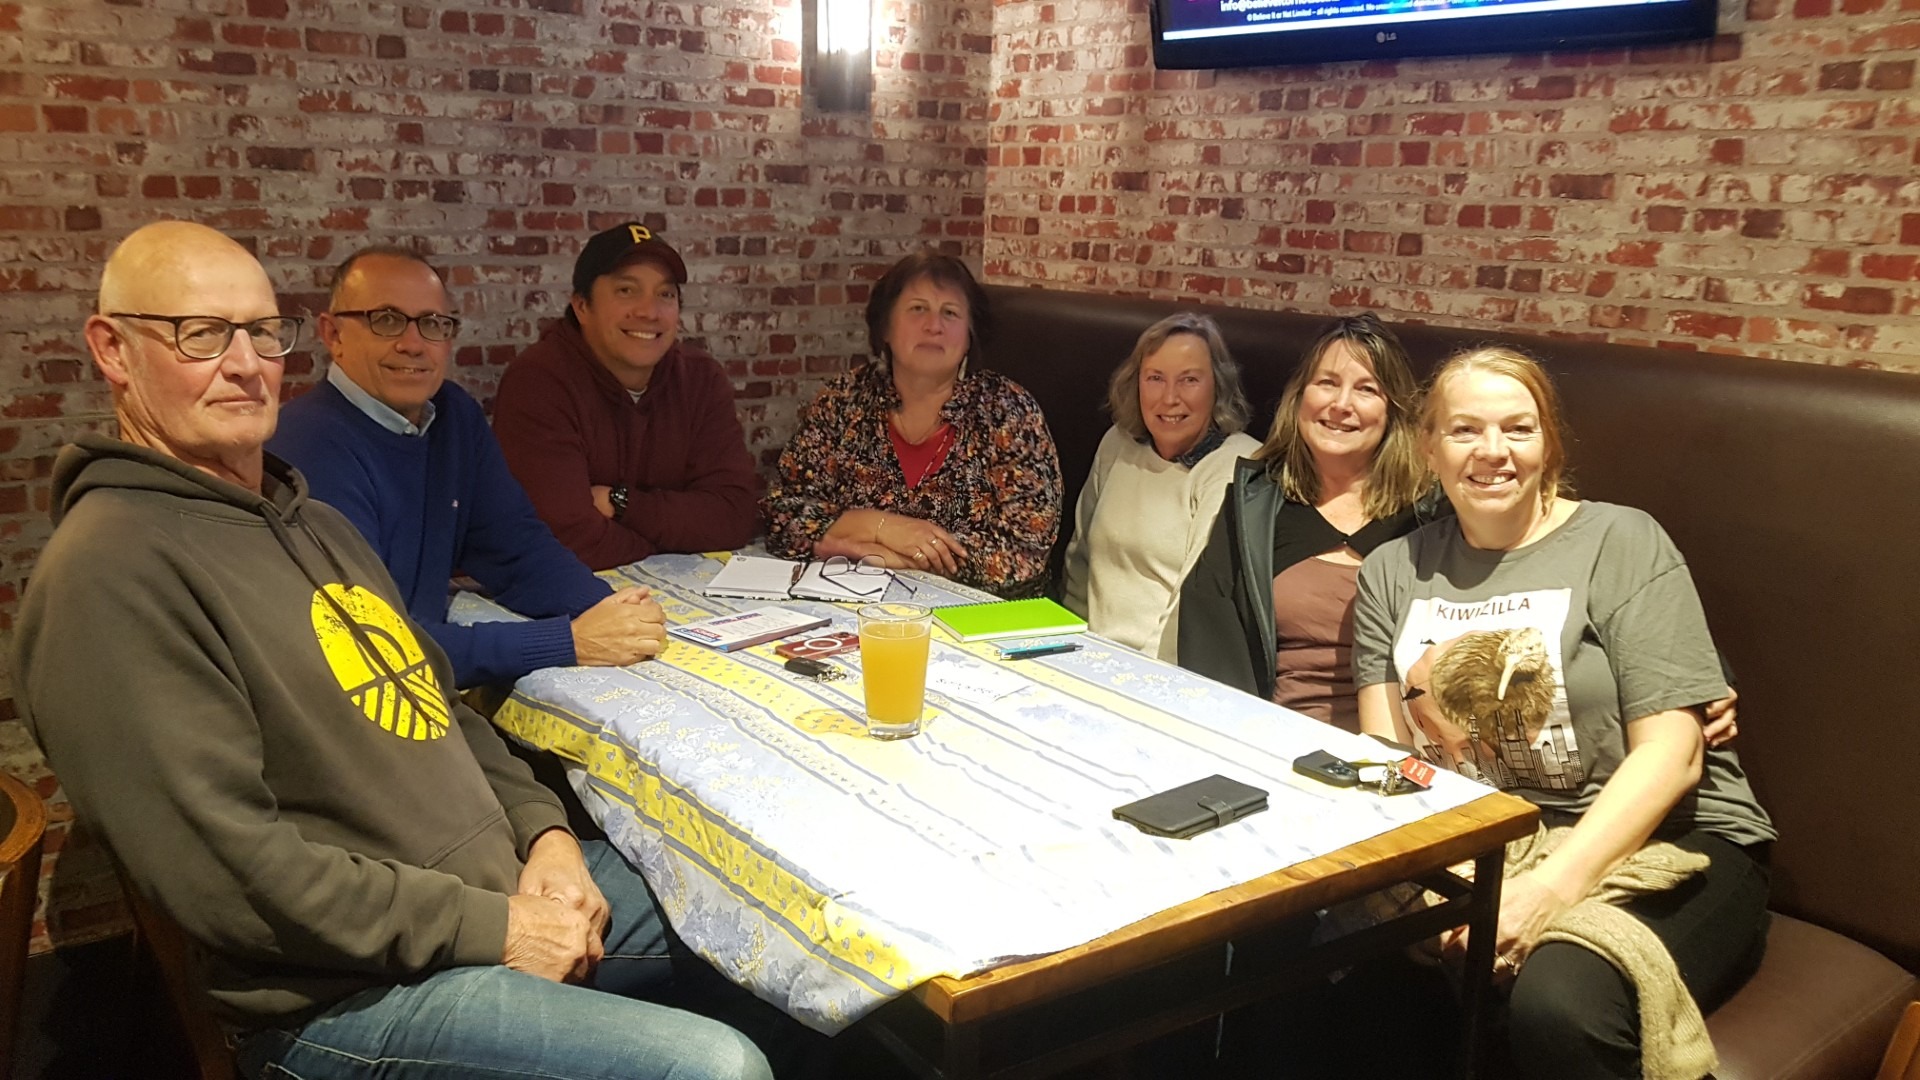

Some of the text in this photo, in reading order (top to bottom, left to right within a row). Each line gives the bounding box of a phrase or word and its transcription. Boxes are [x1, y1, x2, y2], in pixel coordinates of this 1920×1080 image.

[1292, 9, 1311, 17] Limited
[1324, 6, 1339, 16] rights
[1386, 32, 1397, 41] LG
[629, 225, 651, 243] P
[1437, 598, 1531, 621] KIWIZILLA
